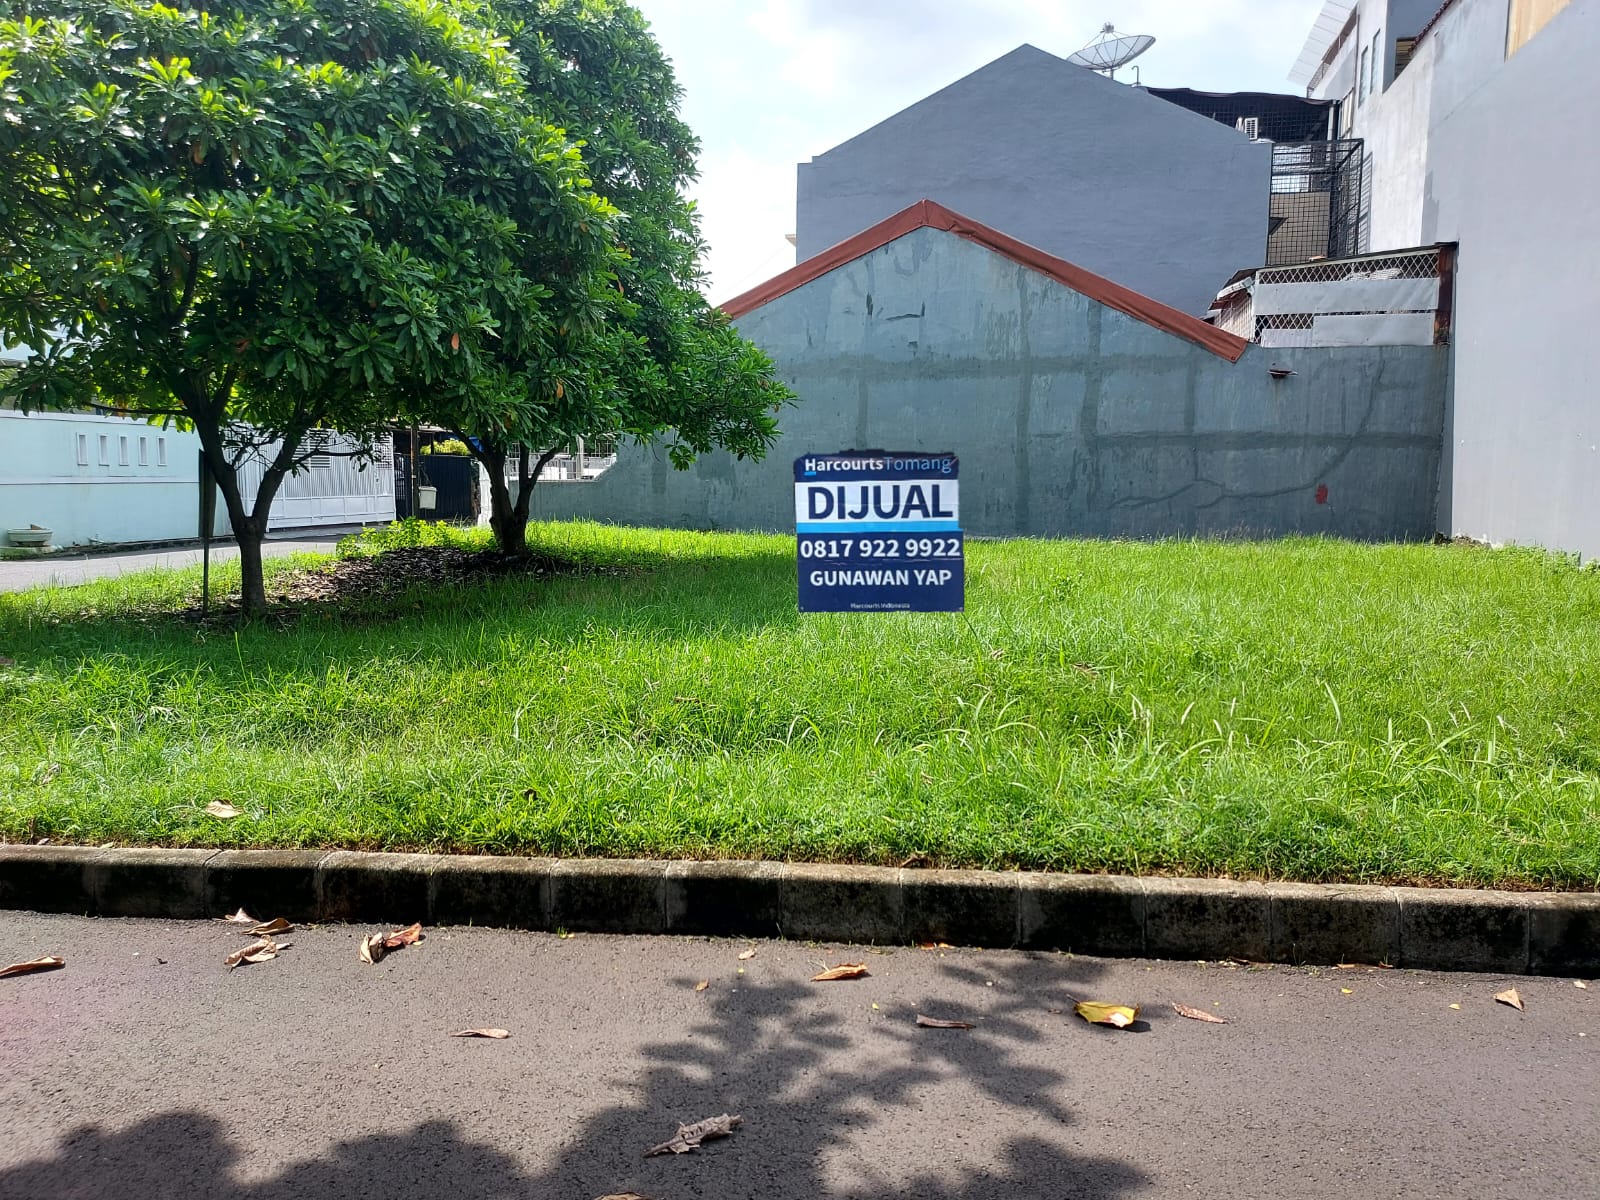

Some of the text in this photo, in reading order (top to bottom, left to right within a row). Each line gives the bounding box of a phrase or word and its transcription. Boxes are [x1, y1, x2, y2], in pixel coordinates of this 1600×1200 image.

[807, 484, 953, 520] DIJUAL
[800, 538, 961, 558] 0817 922 9922
[810, 569, 953, 586] GUNAWAN YAP
